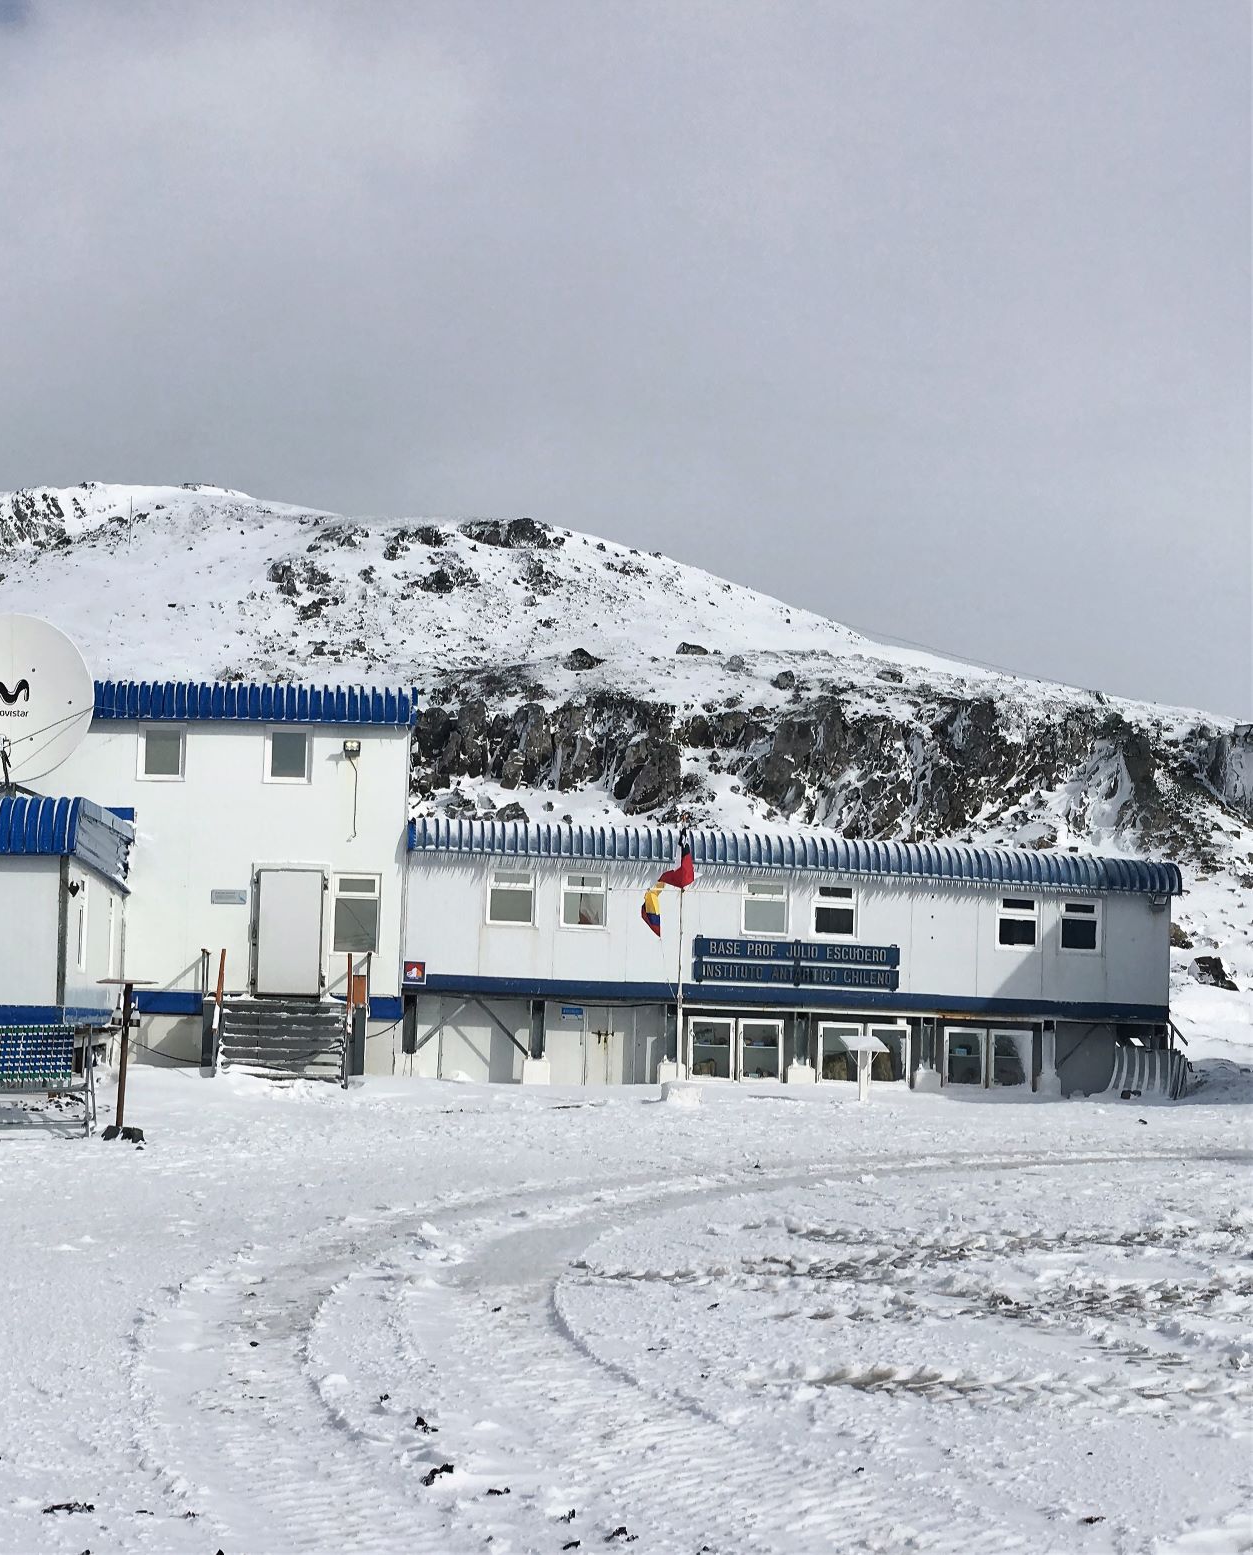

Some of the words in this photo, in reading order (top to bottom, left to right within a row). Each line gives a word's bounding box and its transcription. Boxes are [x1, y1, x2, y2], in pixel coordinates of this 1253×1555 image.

[709, 941, 741, 955] BASE
[786, 944, 818, 959] JULIO
[826, 946, 887, 962] ESCUDERO
[702, 964, 763, 979] INSTITUTO
[843, 969, 891, 985] CHILENO
